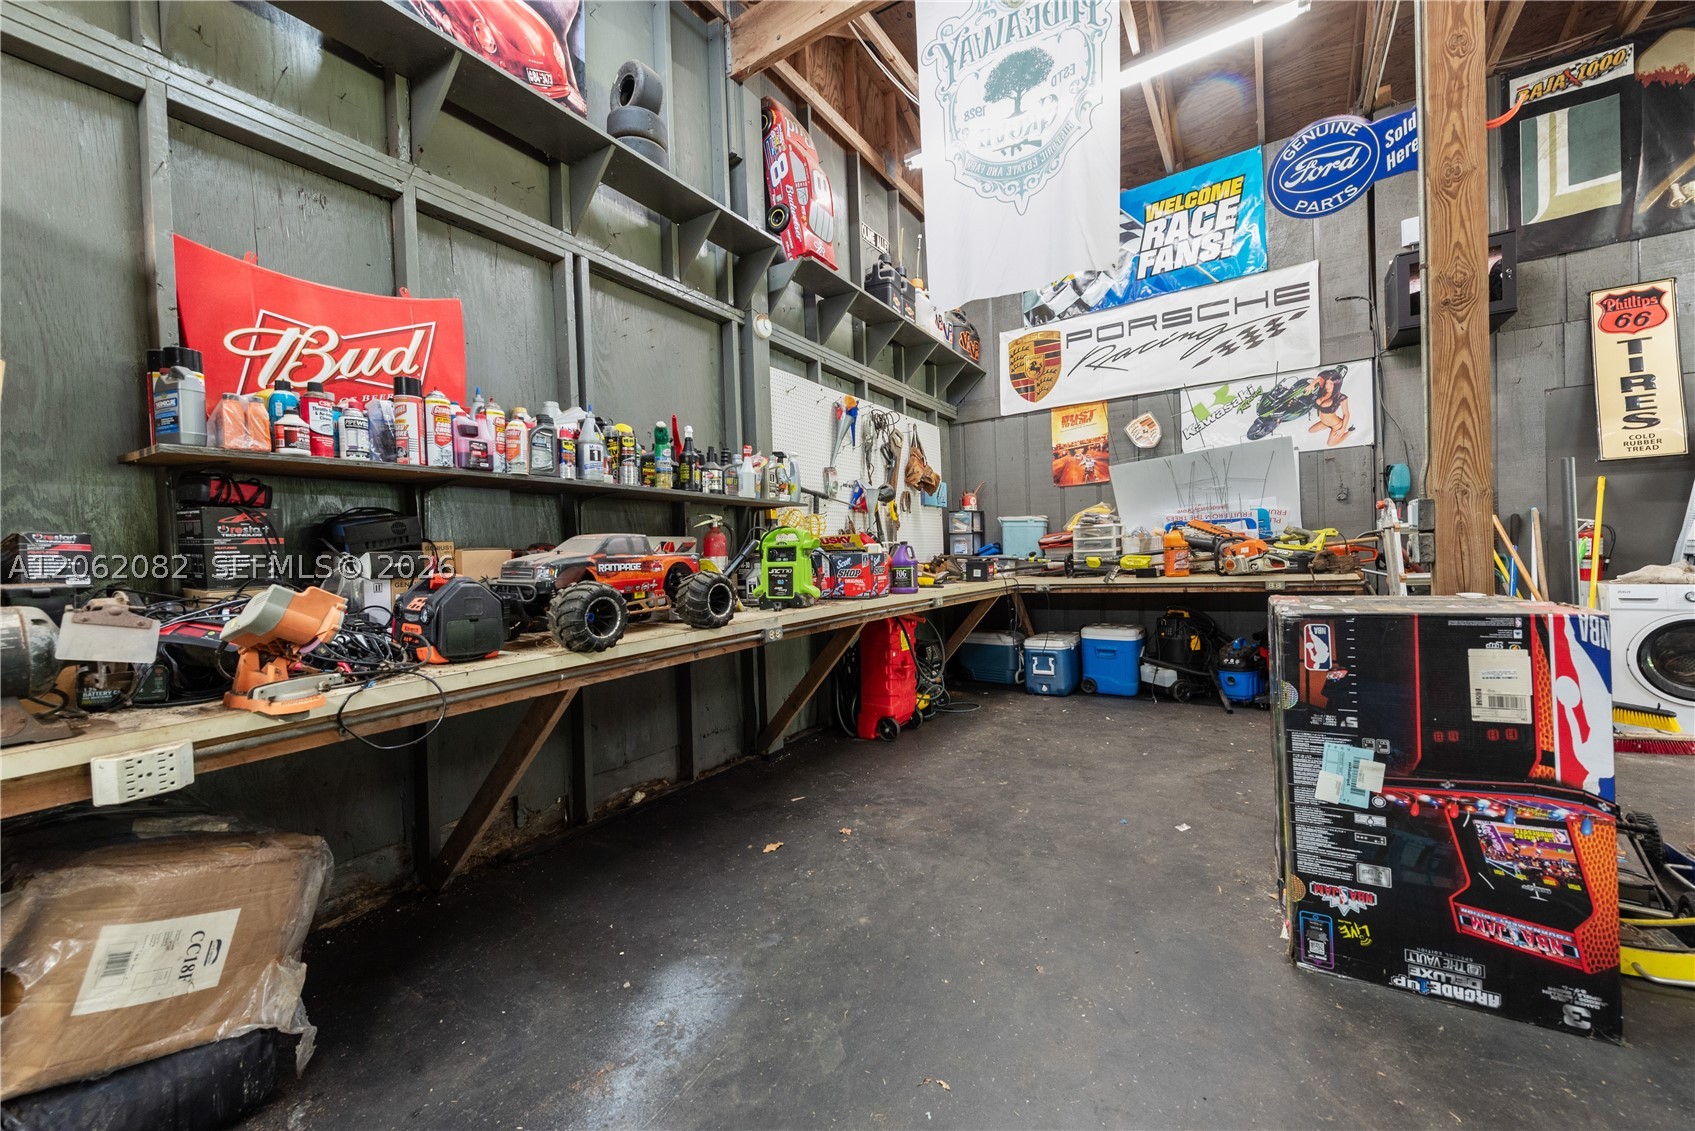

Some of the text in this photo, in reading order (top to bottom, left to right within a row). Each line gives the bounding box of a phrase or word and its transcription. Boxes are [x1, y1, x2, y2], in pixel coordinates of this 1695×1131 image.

[1578, 48, 1627, 83] 1000
[1283, 121, 1362, 161] GENUINE
[1385, 111, 1417, 149] Sold
[1284, 146, 1362, 189] Ford
[1386, 138, 1418, 172] Here
[770, 152, 789, 188] 8
[1144, 175, 1245, 223] WELCOME
[1295, 184, 1359, 213] PARTS
[785, 184, 802, 242] Budweiser
[1141, 194, 1243, 252] RACE
[1136, 228, 1236, 280] FANS!
[1066, 281, 1310, 349] PORSCHE
[1603, 295, 1659, 313] Phillips
[1614, 311, 1652, 329] 66
[223, 324, 426, 388] Bud
[1067, 315, 1262, 377] Racing
[1617, 336, 1661, 430] TIRES
[1061, 408, 1097, 424] DUST
[1182, 384, 1255, 440] Kawasaki
[1623, 438, 1663, 447] RUBBER
[1626, 444, 1660, 452] TREAD
[1629, 432, 1656, 440] COLD
[43, 533, 77, 542] restart
[230, 525, 270, 534] restat
[819, 536, 852, 545] USKY
[598, 563, 642, 573] RAMPAGE
[837, 556, 853, 569] Scott
[837, 568, 862, 578] SHOP
[896, 570, 908, 579] FOG
[1313, 626, 1327, 635] NBA
[1578, 614, 1611, 650] NBA
[1313, 883, 1374, 904] NBA JAM
[1460, 907, 1572, 942] TOURNAMENT EDITION
[1470, 916, 1564, 957] NBA JAM
[1407, 951, 1466, 973] THE VAULT
[1416, 947, 1474, 962] SPECIAL EDITION
[1409, 965, 1483, 990] DELUXE
[1562, 1003, 1592, 1030] 3
